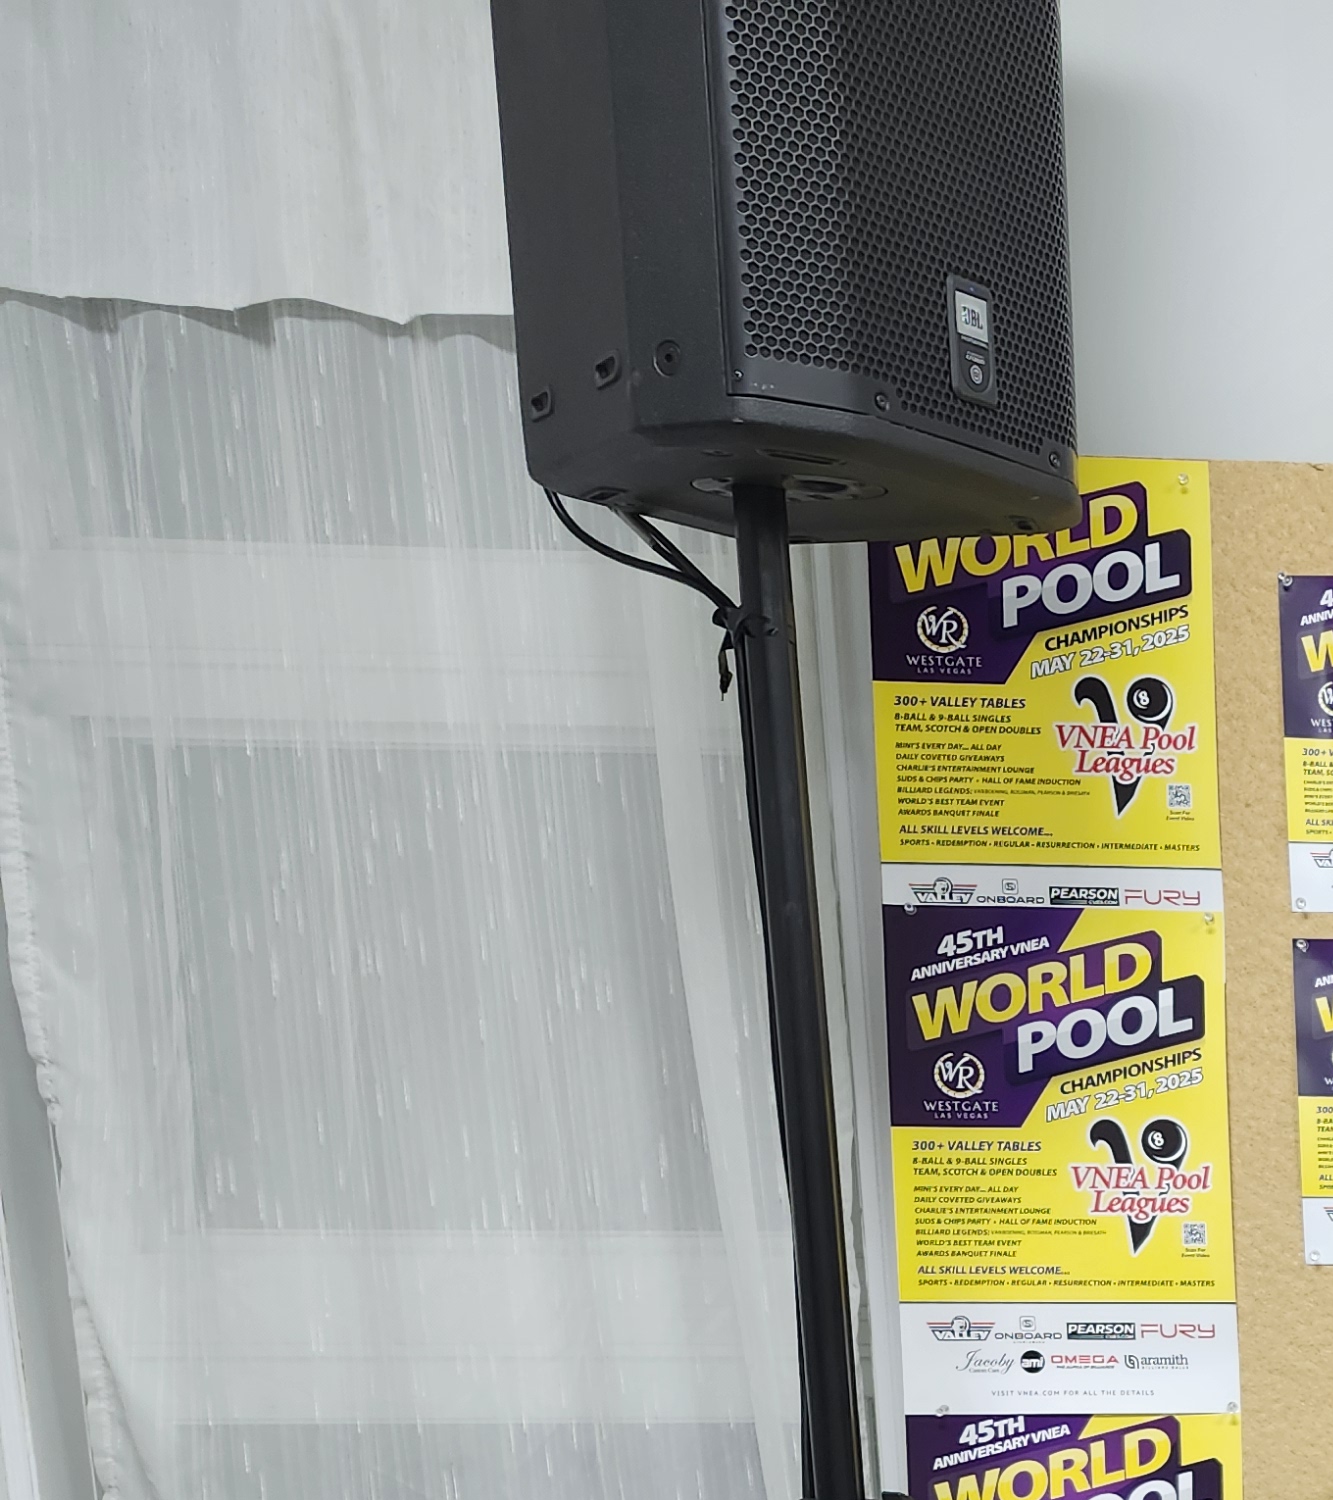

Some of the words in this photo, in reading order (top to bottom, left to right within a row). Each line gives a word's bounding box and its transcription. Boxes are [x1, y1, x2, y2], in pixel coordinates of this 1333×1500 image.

[964, 306, 983, 330] JBL
[1003, 542, 1180, 628] POOL
[1045, 605, 1188, 651] CHAMPIONSHIPS
[1055, 724, 1133, 750] VNEA
[1141, 724, 1196, 752] Pool
[1075, 752, 1175, 781] Leagues
[937, 926, 1003, 957] 45TH
[911, 945, 1010, 981] ANNIVERSARY
[1010, 936, 1050, 956] VNEA
[912, 942, 1152, 1040] WORLD
[1017, 987, 1193, 1073] POOL
[1060, 1048, 1202, 1095] CHAMPIONSHIPS
[923, 1101, 998, 1112] WESTGATE
[1046, 1093, 1090, 1122] MAY
[1094, 1081, 1154, 1110] 22-31,
[1155, 1068, 1203, 1095] 2025
[912, 1141, 945, 1151] 300+
[948, 1141, 993, 1151] VALLEY
[997, 1141, 1042, 1152] TABLES
[912, 1157, 945, 1165] 8-BALL
[946, 1157, 953, 1165] &
[956, 1157, 987, 1165] 9-BALL
[989, 1157, 1027, 1165] SINGLES
[943, 1168, 978, 1176] SCOTCH
[980, 1168, 987, 1176] &
[988, 1168, 1014, 1176] OPEN
[1015, 1168, 1057, 1177] DOUBLES
[1071, 1166, 1149, 1189] VNEA
[1155, 1165, 1211, 1190] Pool
[1091, 1190, 1190, 1221] Leagues
[917, 1266, 937, 1275] ALL
[938, 1266, 967, 1275] SKILL
[969, 1266, 1006, 1275] LEVELS
[994, 1331, 1062, 1340] ONBOARD
[1068, 1323, 1134, 1335] PEARSON
[1140, 1323, 1215, 1339] FURY
[956, 1349, 1015, 1375] Jacoby
[1051, 1355, 1119, 1365] OMEGA
[1140, 1354, 1189, 1367] aramith
